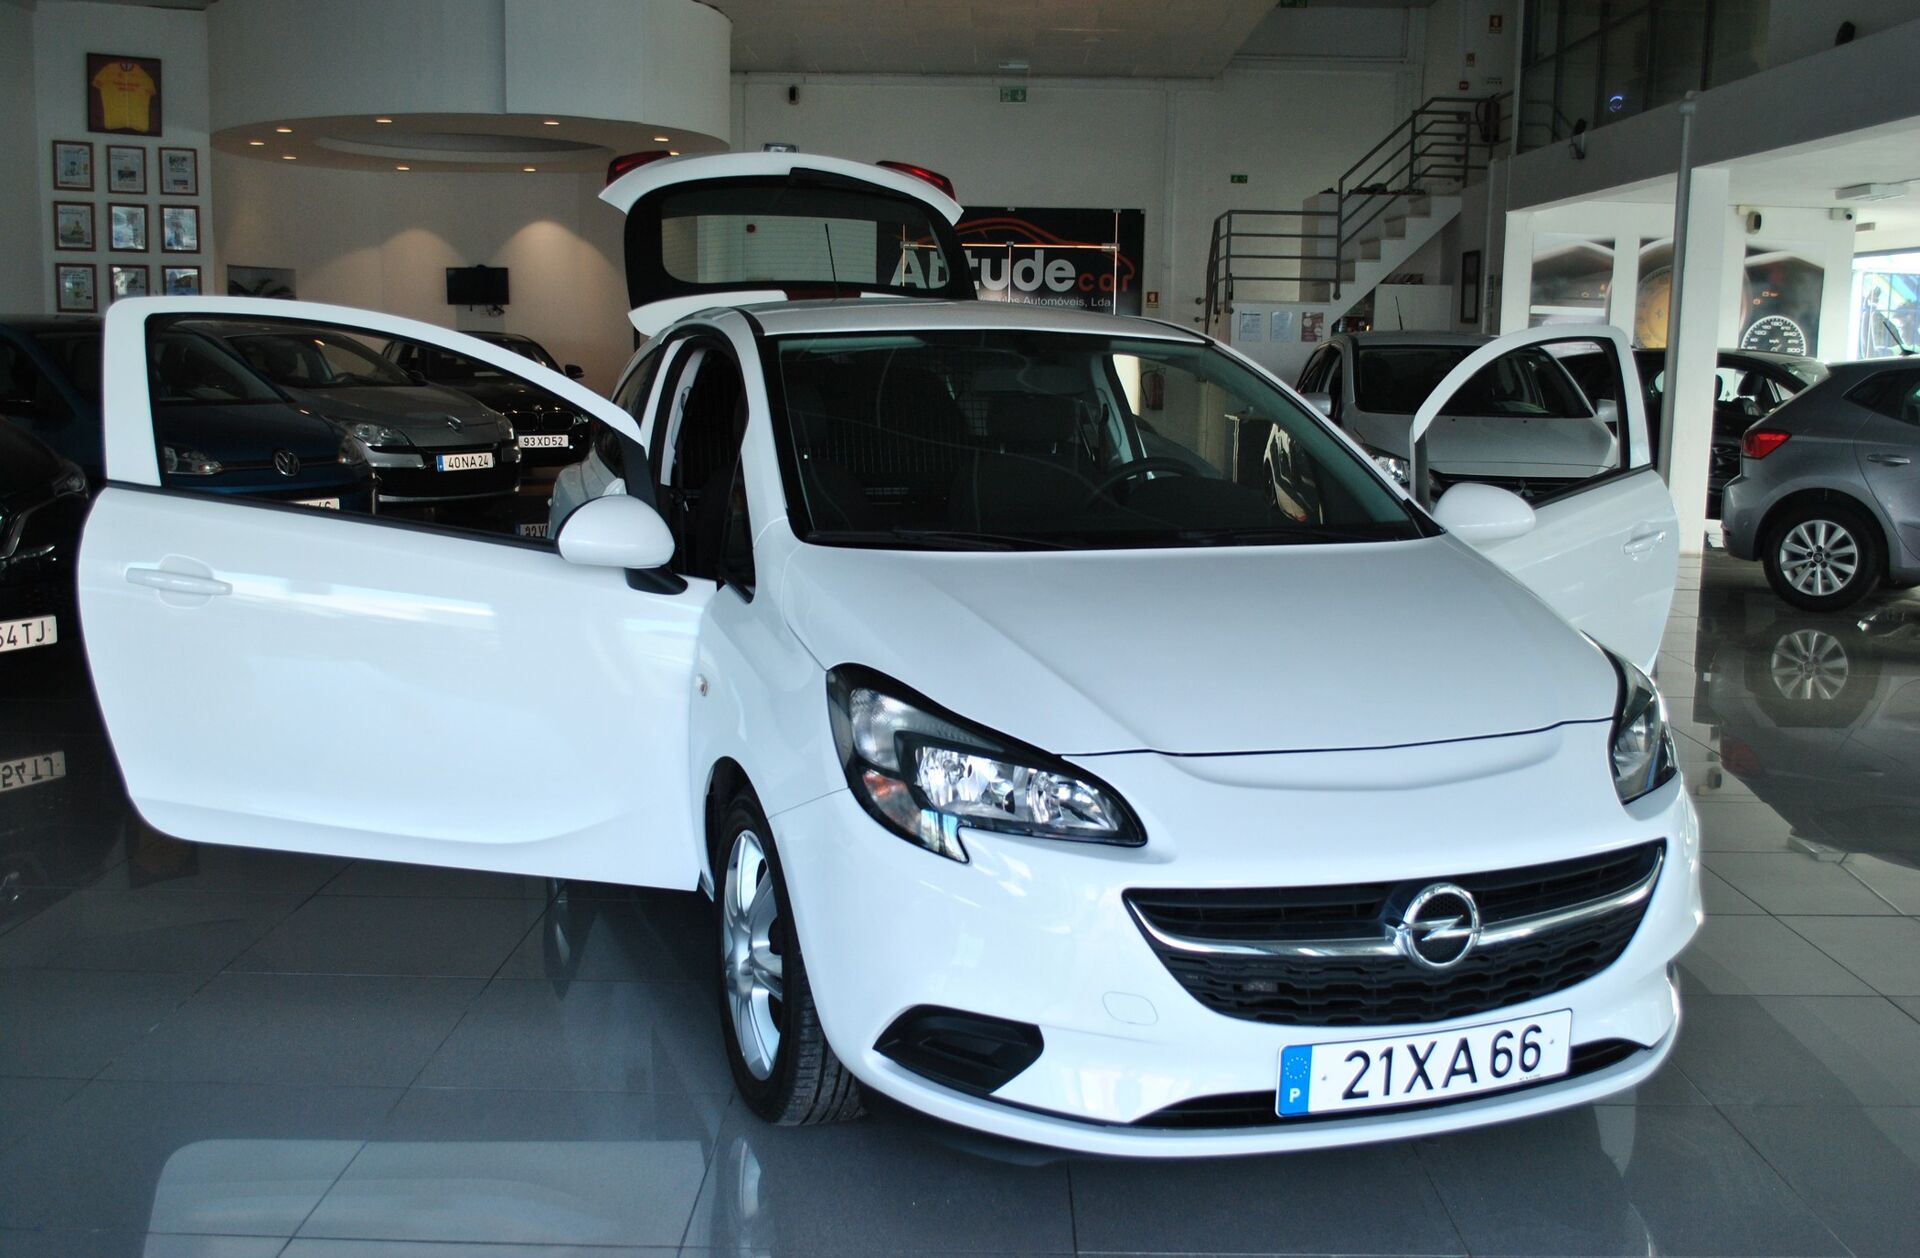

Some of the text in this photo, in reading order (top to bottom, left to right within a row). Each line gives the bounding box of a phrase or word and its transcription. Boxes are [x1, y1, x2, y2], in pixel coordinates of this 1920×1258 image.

[523, 437, 563, 447] 93XD52
[448, 455, 489, 469] 40NA24
[1289, 1023, 1542, 1103] P 21XA66
